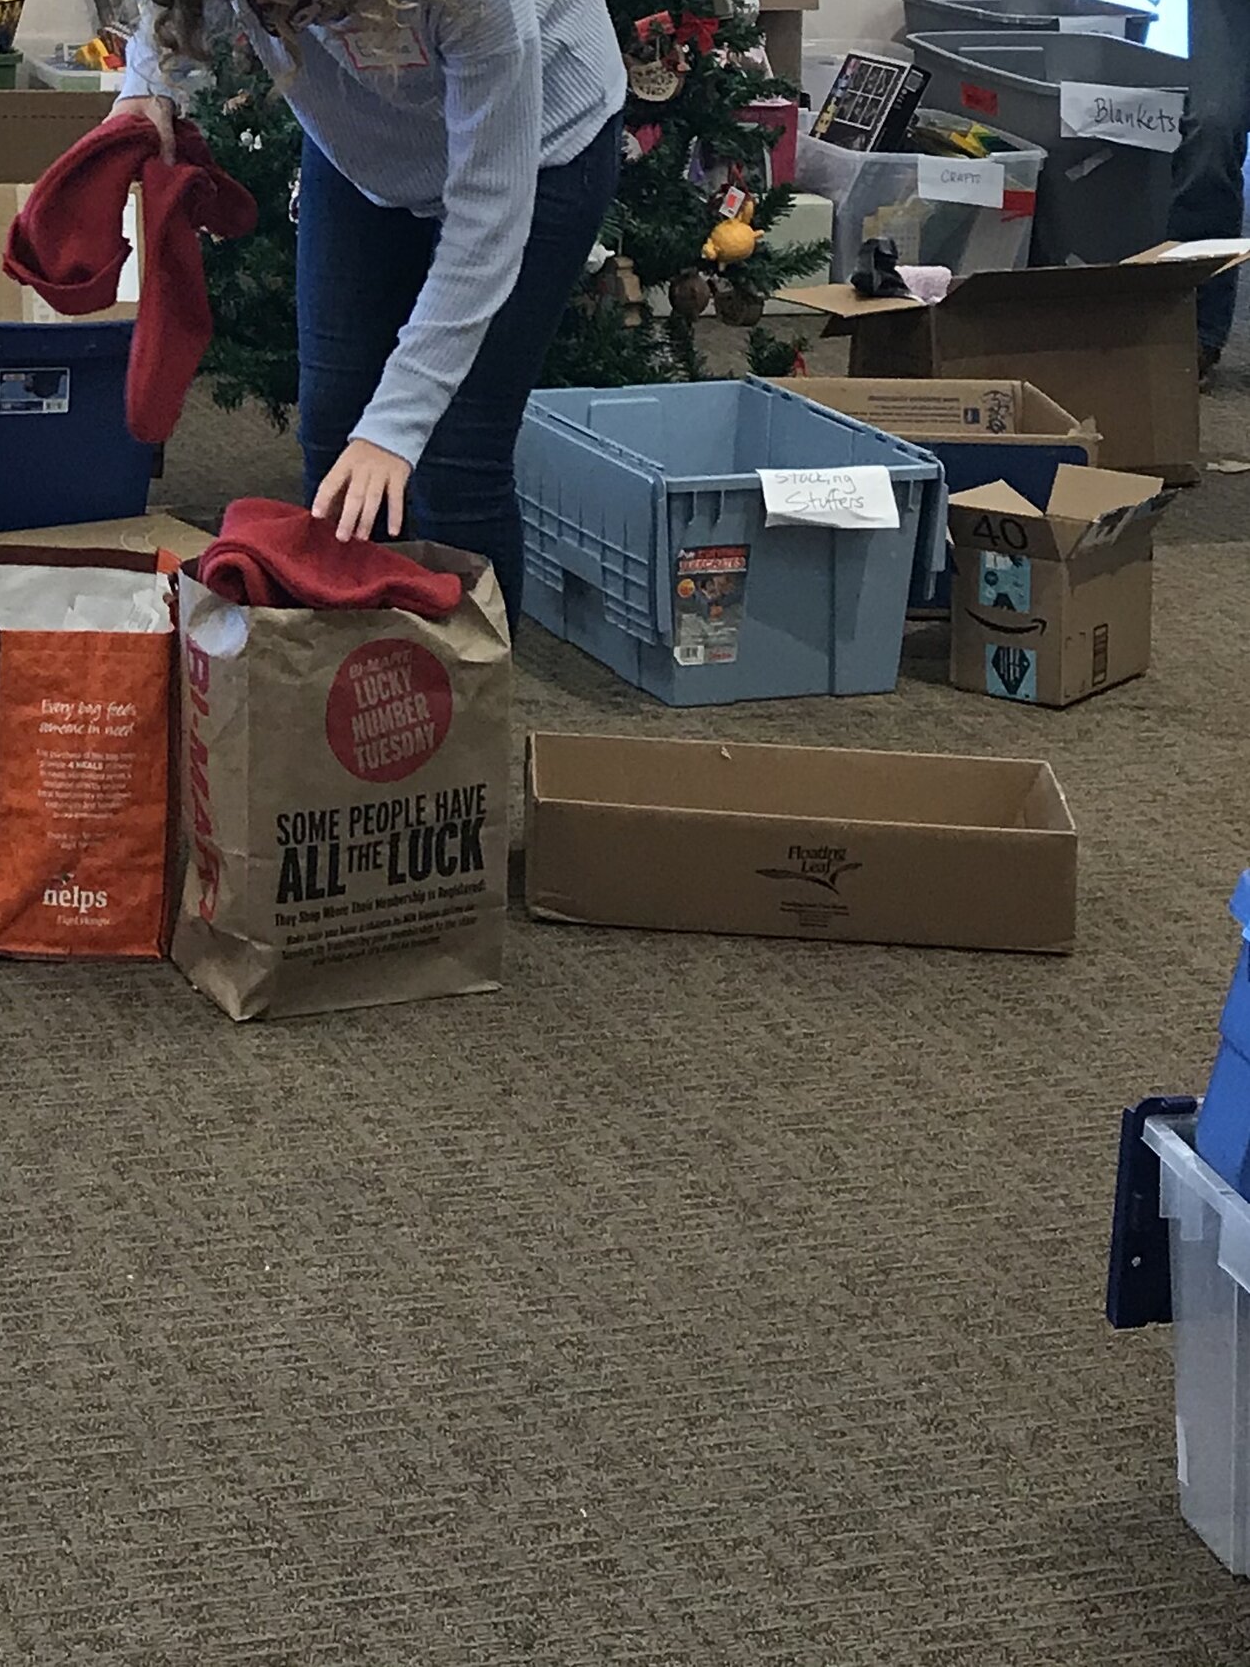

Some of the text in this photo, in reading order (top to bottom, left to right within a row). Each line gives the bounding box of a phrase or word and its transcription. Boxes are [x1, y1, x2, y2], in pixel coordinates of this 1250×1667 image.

[1093, 97, 1177, 133] Blankets
[972, 514, 1029, 550] 40
[353, 664, 412, 709] LUCKY
[351, 691, 431, 743] NUMBER
[353, 721, 435, 773] TUESDAY
[275, 783, 487, 847] SOME PEOPLE HAVE
[275, 816, 486, 905] ALL THE LUCK
[375, 889, 426, 910] Membership
